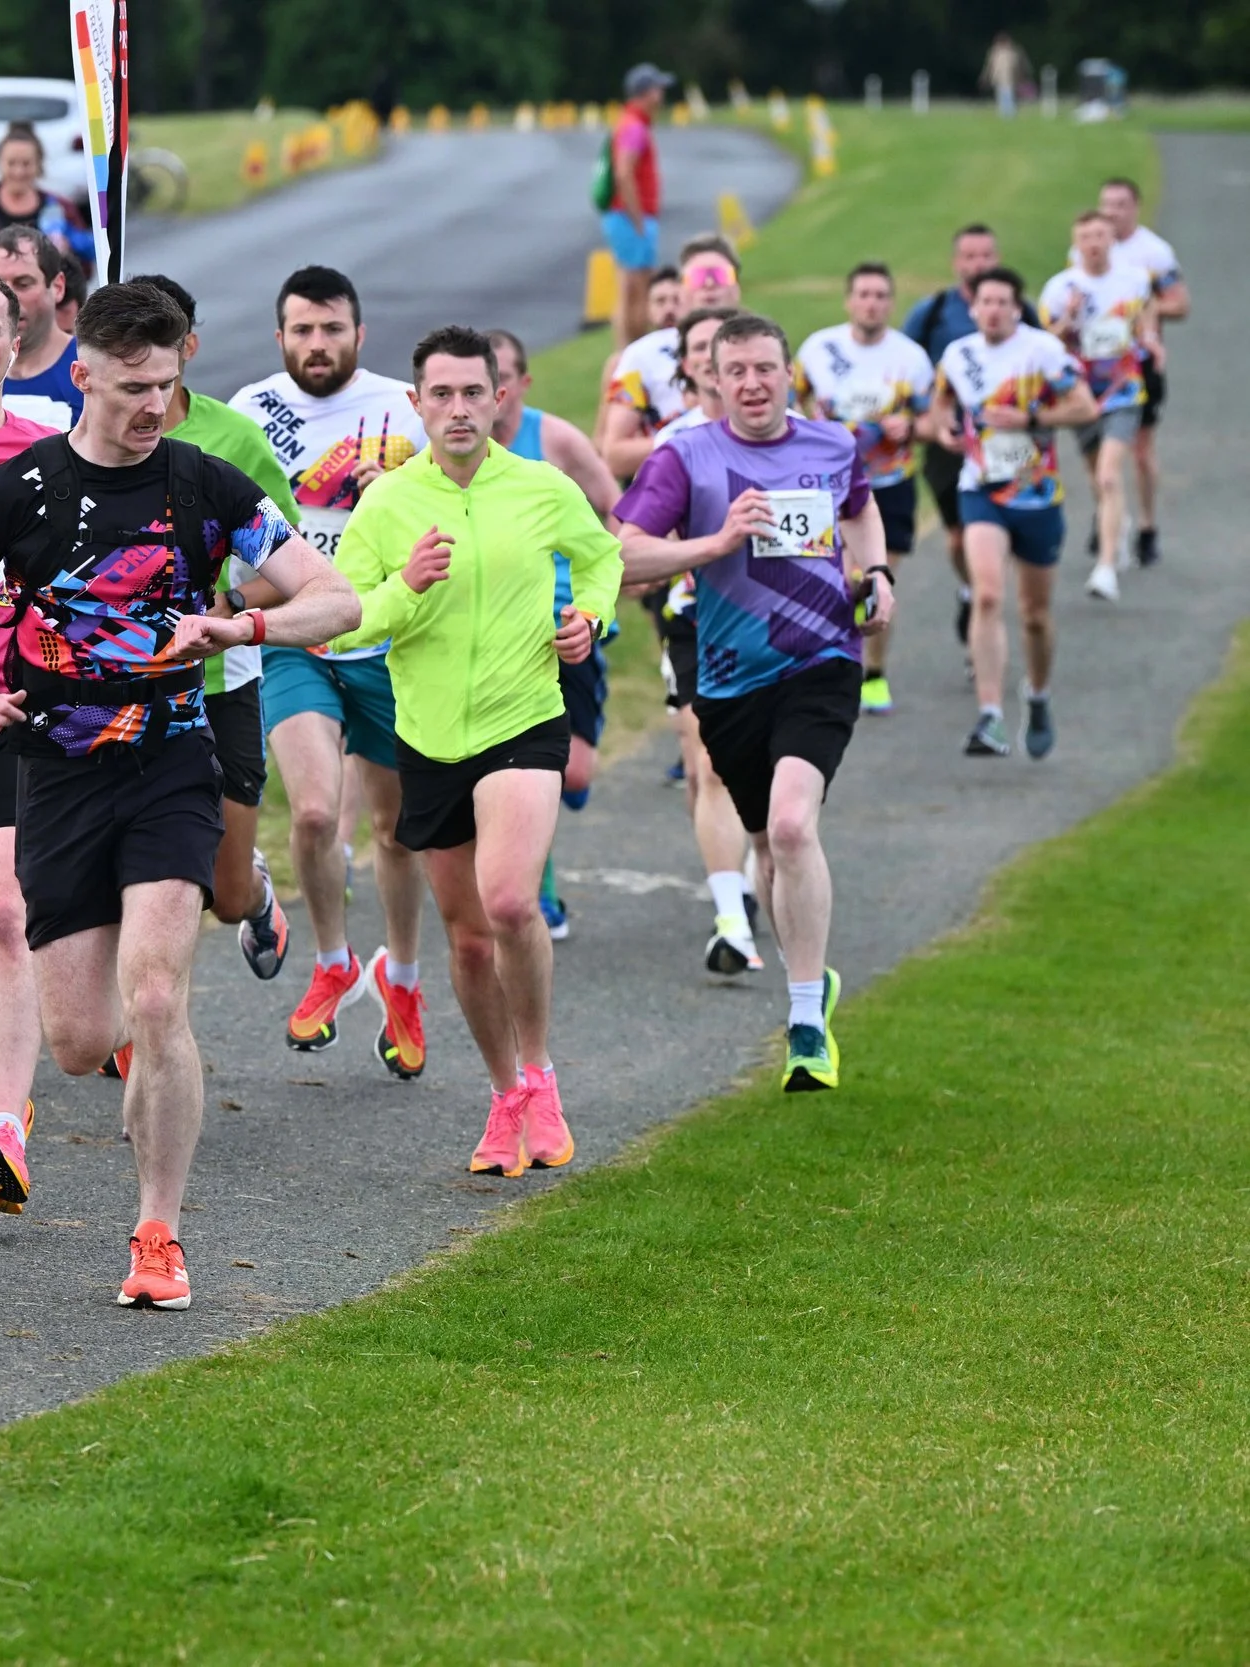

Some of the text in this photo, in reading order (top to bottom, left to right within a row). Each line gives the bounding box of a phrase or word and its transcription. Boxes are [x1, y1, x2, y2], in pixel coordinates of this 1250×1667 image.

[263, 421, 306, 460] RUN
[312, 434, 357, 483] PRIDE
[779, 513, 809, 537] 43
